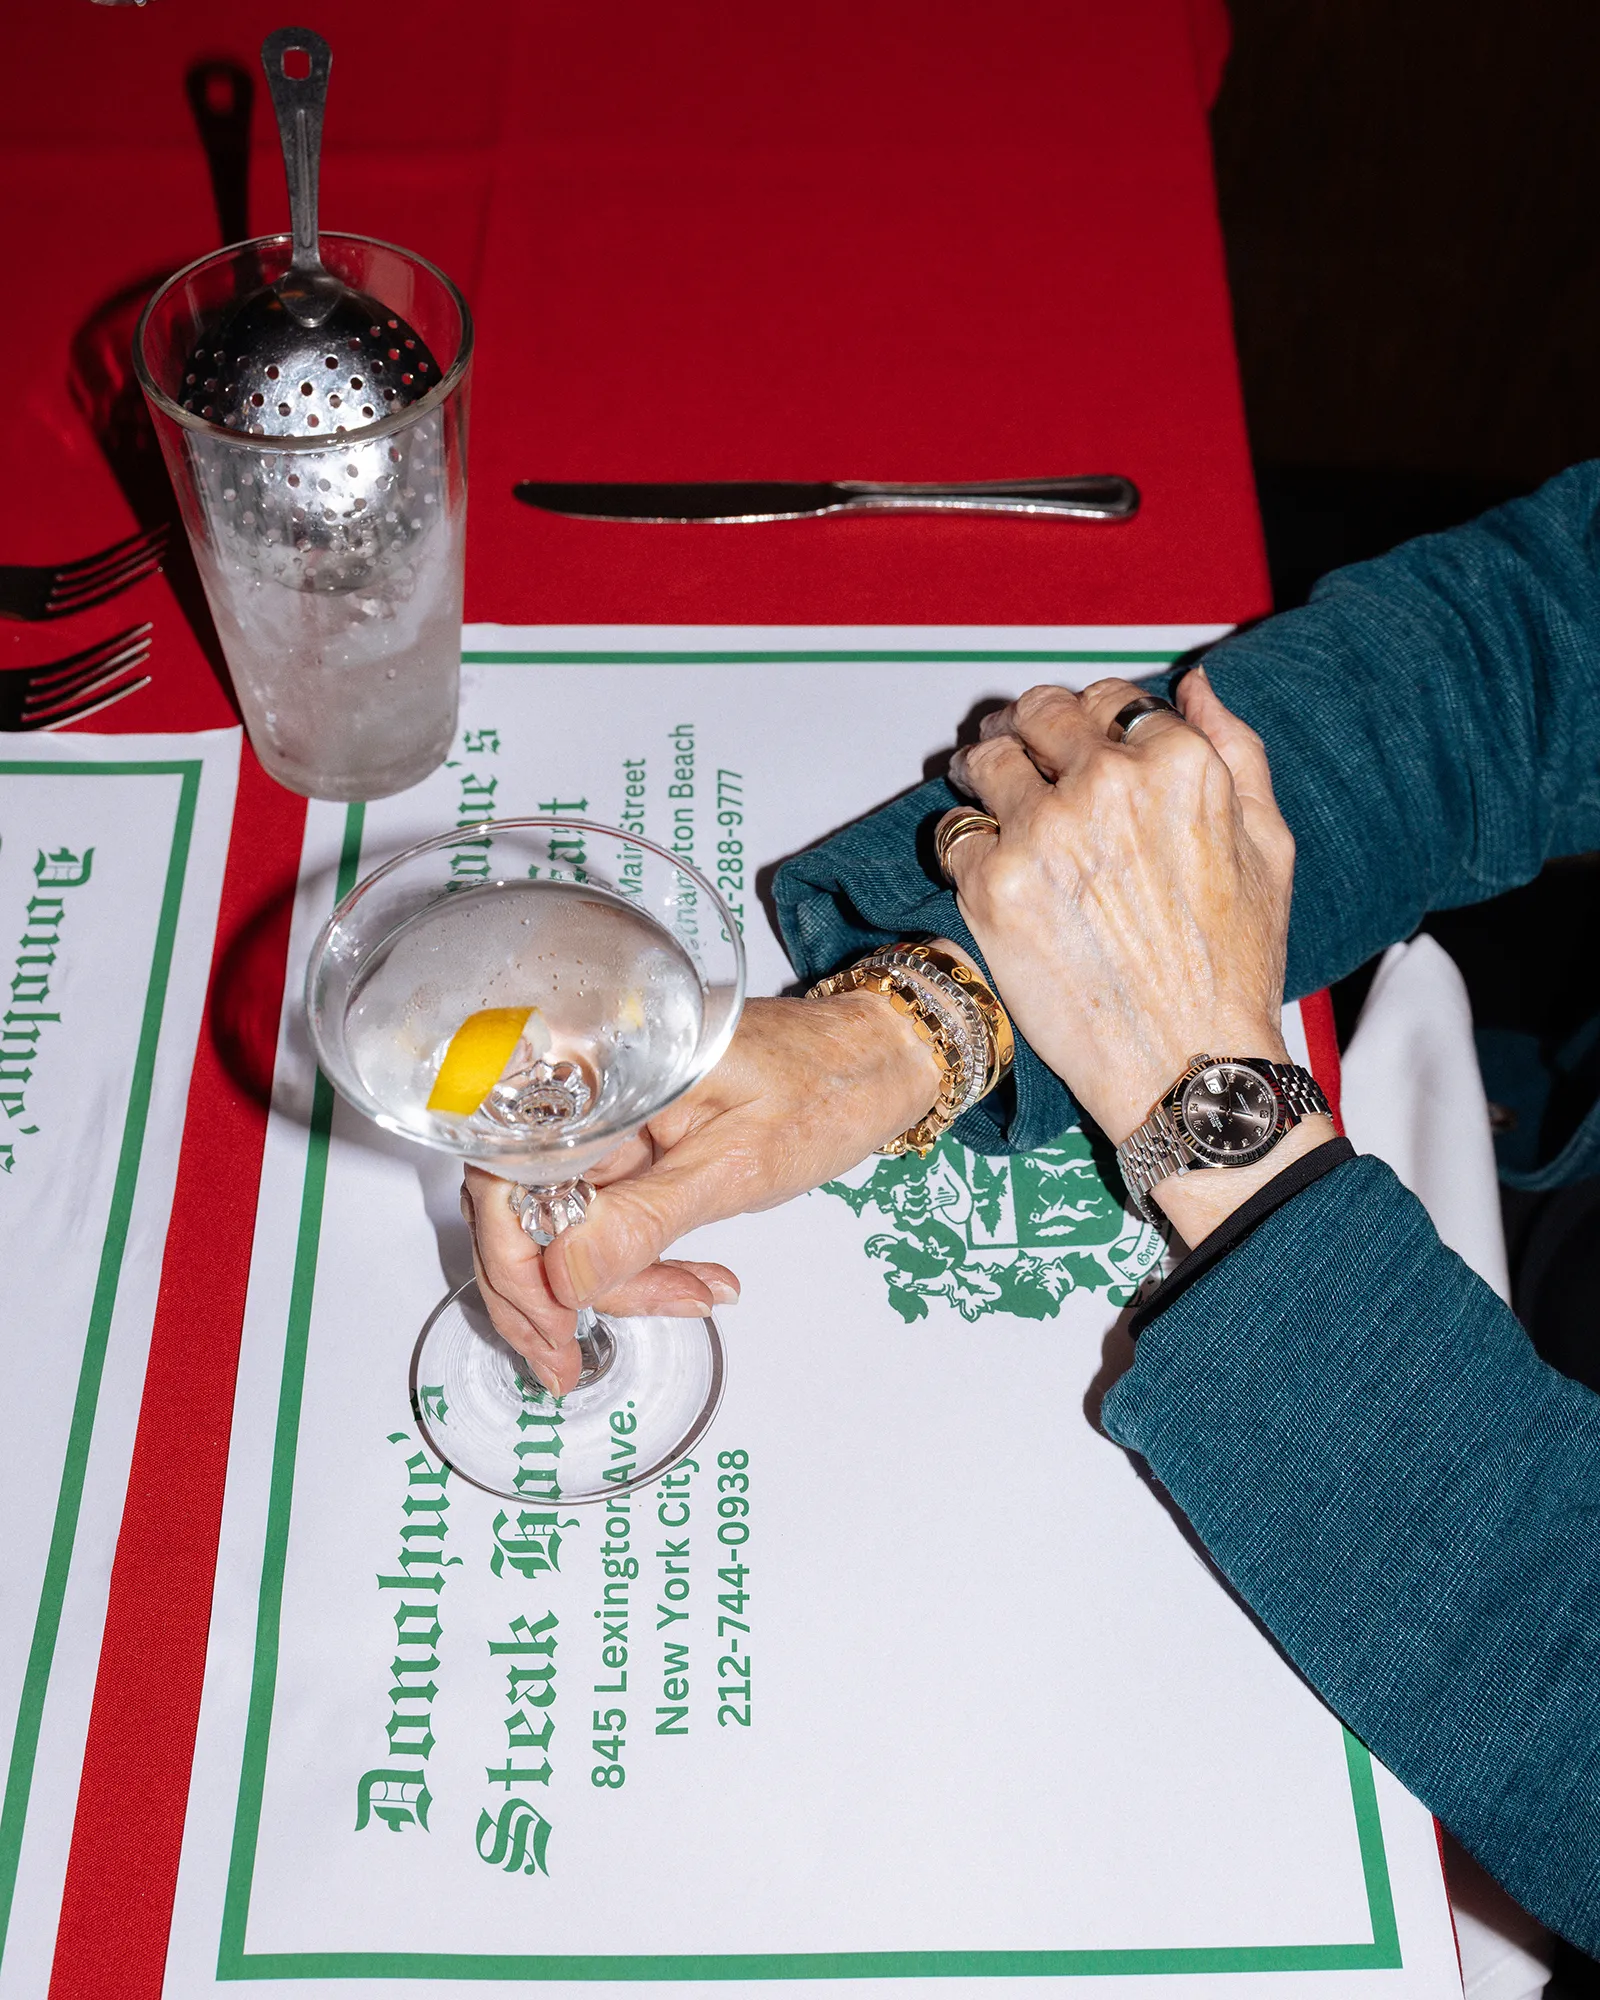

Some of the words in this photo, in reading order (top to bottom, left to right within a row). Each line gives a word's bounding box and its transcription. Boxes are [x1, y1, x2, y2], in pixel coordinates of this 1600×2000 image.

[620, 757, 646, 836] Street
[668, 723, 695, 799] Beach
[488, 1372, 580, 1581] Hou
[602, 1400, 638, 1489] Ave.
[656, 1456, 700, 1527] City
[354, 1384, 466, 1834] Donohue's
[593, 1488, 640, 1693] Lexington
[655, 1536, 691, 1631] York
[716, 1448, 752, 1728] 212-744-0938
[655, 1641, 690, 1736] New
[475, 1608, 560, 1877] Steak
[591, 1707, 627, 1790] 845
